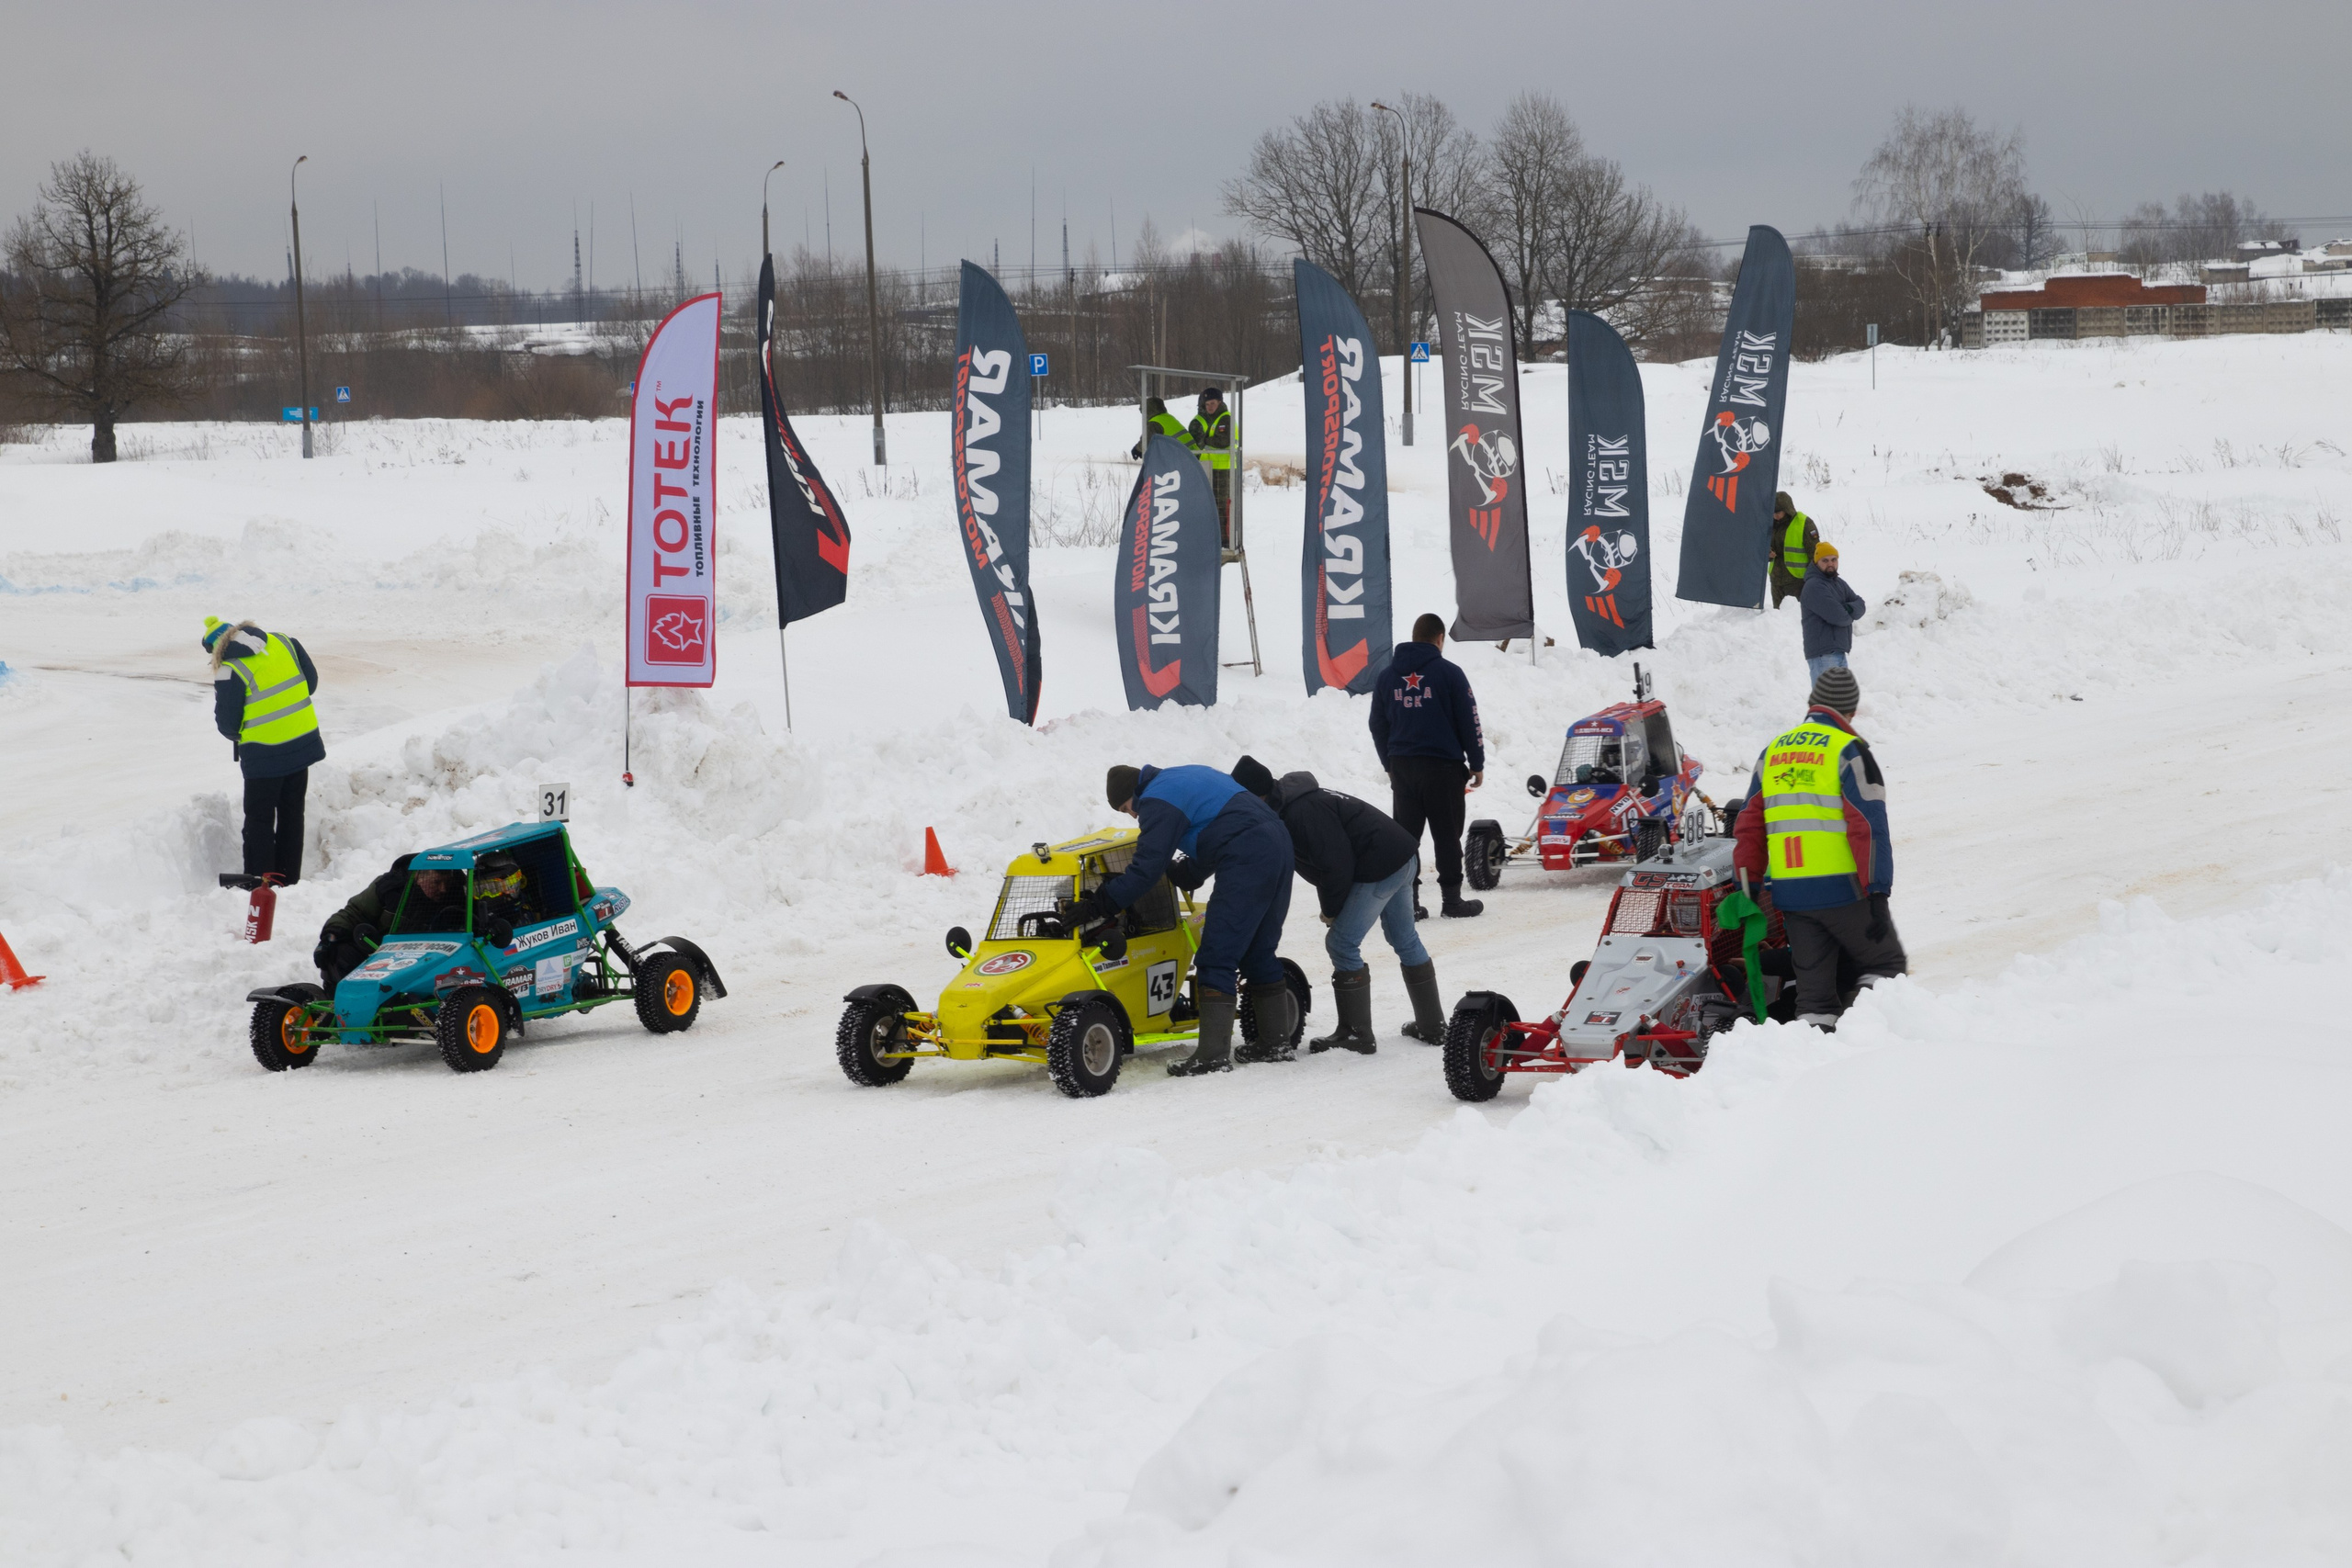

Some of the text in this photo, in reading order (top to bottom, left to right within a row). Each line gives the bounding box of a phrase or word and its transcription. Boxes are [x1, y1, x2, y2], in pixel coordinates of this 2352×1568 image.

[1035, 356, 1045, 373] P
[653, 393, 694, 588] ТОТЕК
[693, 400, 705, 578] ТОПЛИВНЫЕ ТЕХНОЛОГИИ
[1394, 686, 1432, 708] ЦСКА
[1774, 731, 1832, 749] RUSTA
[1770, 751, 1826, 767] МАРШАЛ
[543, 790, 566, 817] 31
[1611, 796, 1631, 813] NWB
[1622, 807, 1639, 832] 19
[1687, 809, 1704, 846] 88
[1632, 872, 1669, 887] GS
[248, 905, 260, 918] 2
[516, 921, 577, 949] Жуков Иван
[503, 974, 533, 987] RAMAR
[1150, 972, 1174, 1002] 43
